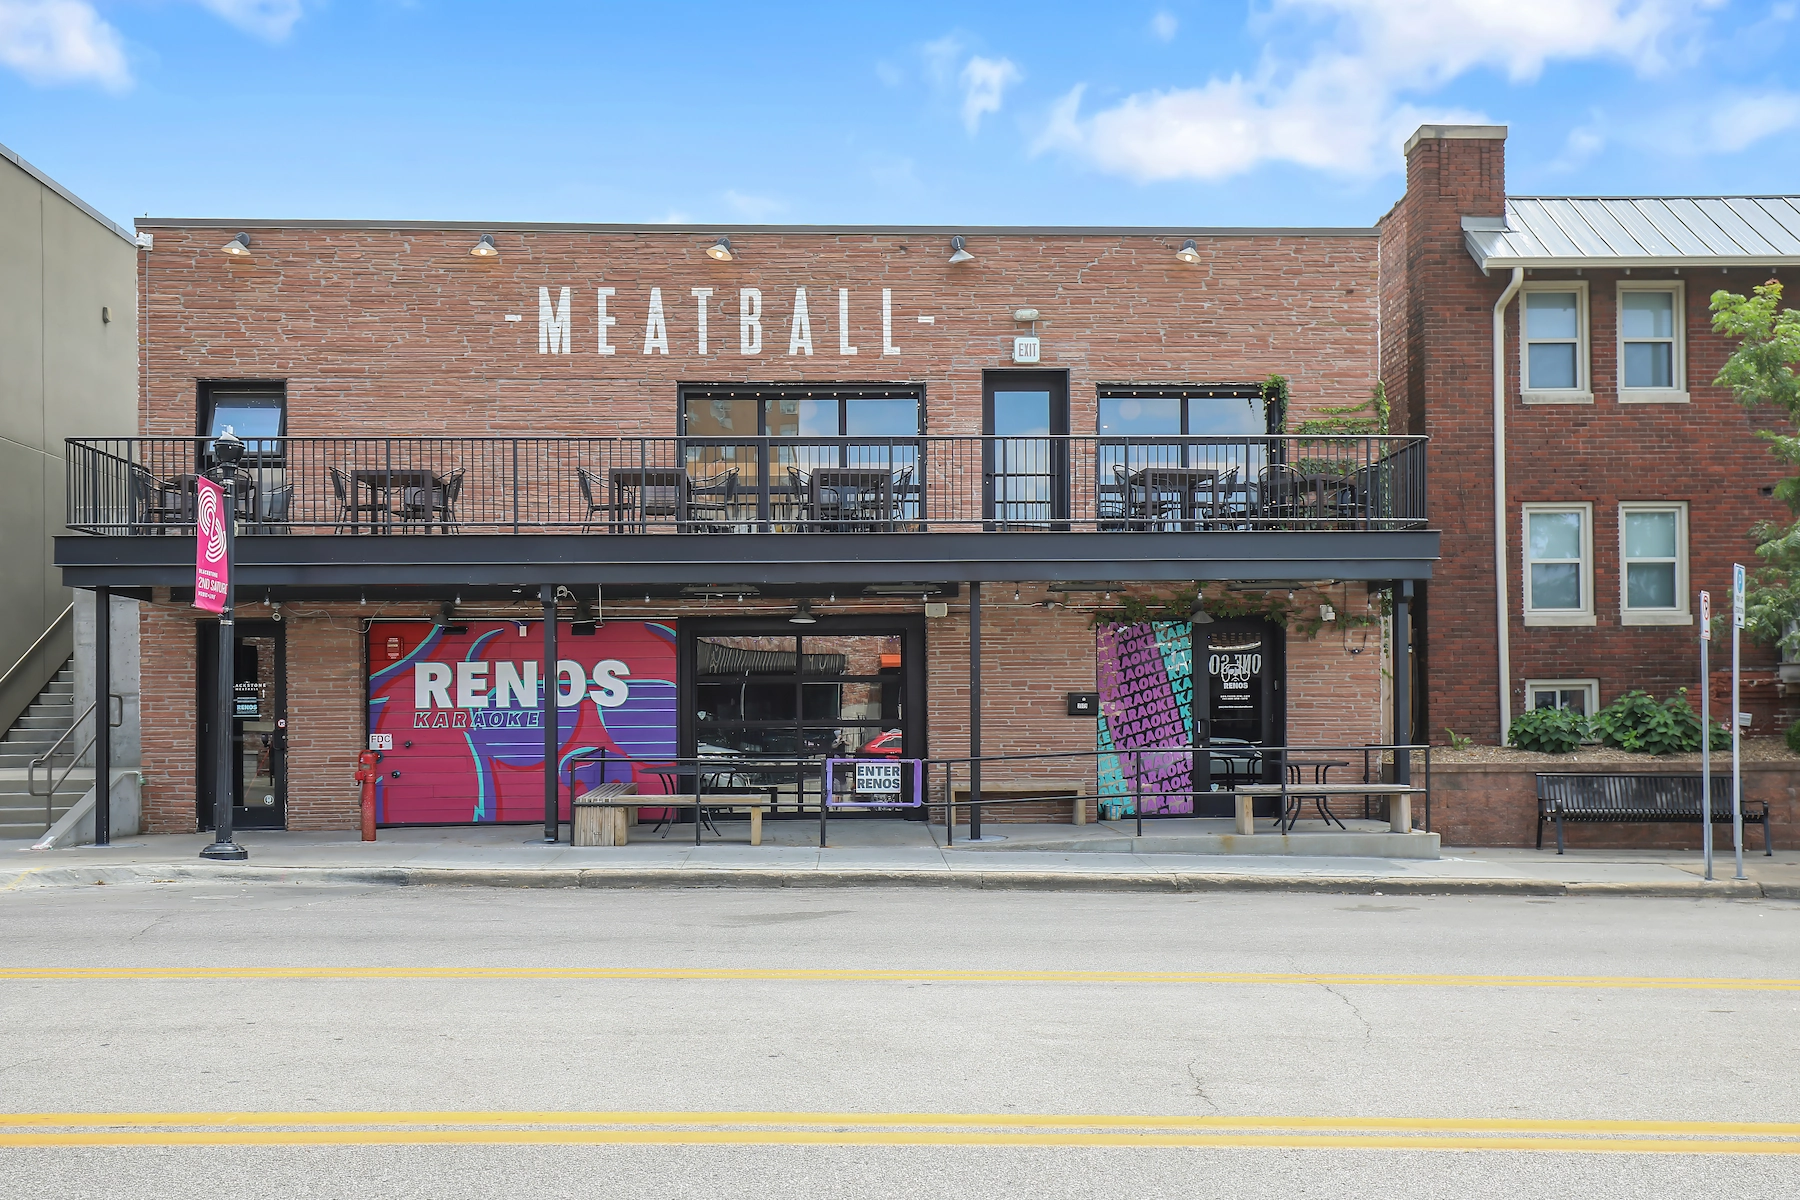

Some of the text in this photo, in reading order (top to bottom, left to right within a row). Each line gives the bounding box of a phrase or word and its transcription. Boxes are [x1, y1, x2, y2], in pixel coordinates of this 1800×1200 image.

[1018, 343, 1037, 357] EXIT
[198, 576, 210, 590] 2ND
[414, 660, 630, 708] RENOS
[1100, 671, 1167, 702] KARAOKE
[1104, 683, 1171, 715] KARAOKE
[1108, 696, 1176, 727] KARAOKE
[414, 712, 540, 728] KARAOKE
[1111, 708, 1179, 740] KARAOKE
[1115, 721, 1184, 750] KARAOKE
[857, 766, 900, 776] ENTER
[857, 779, 900, 789] RENOS
